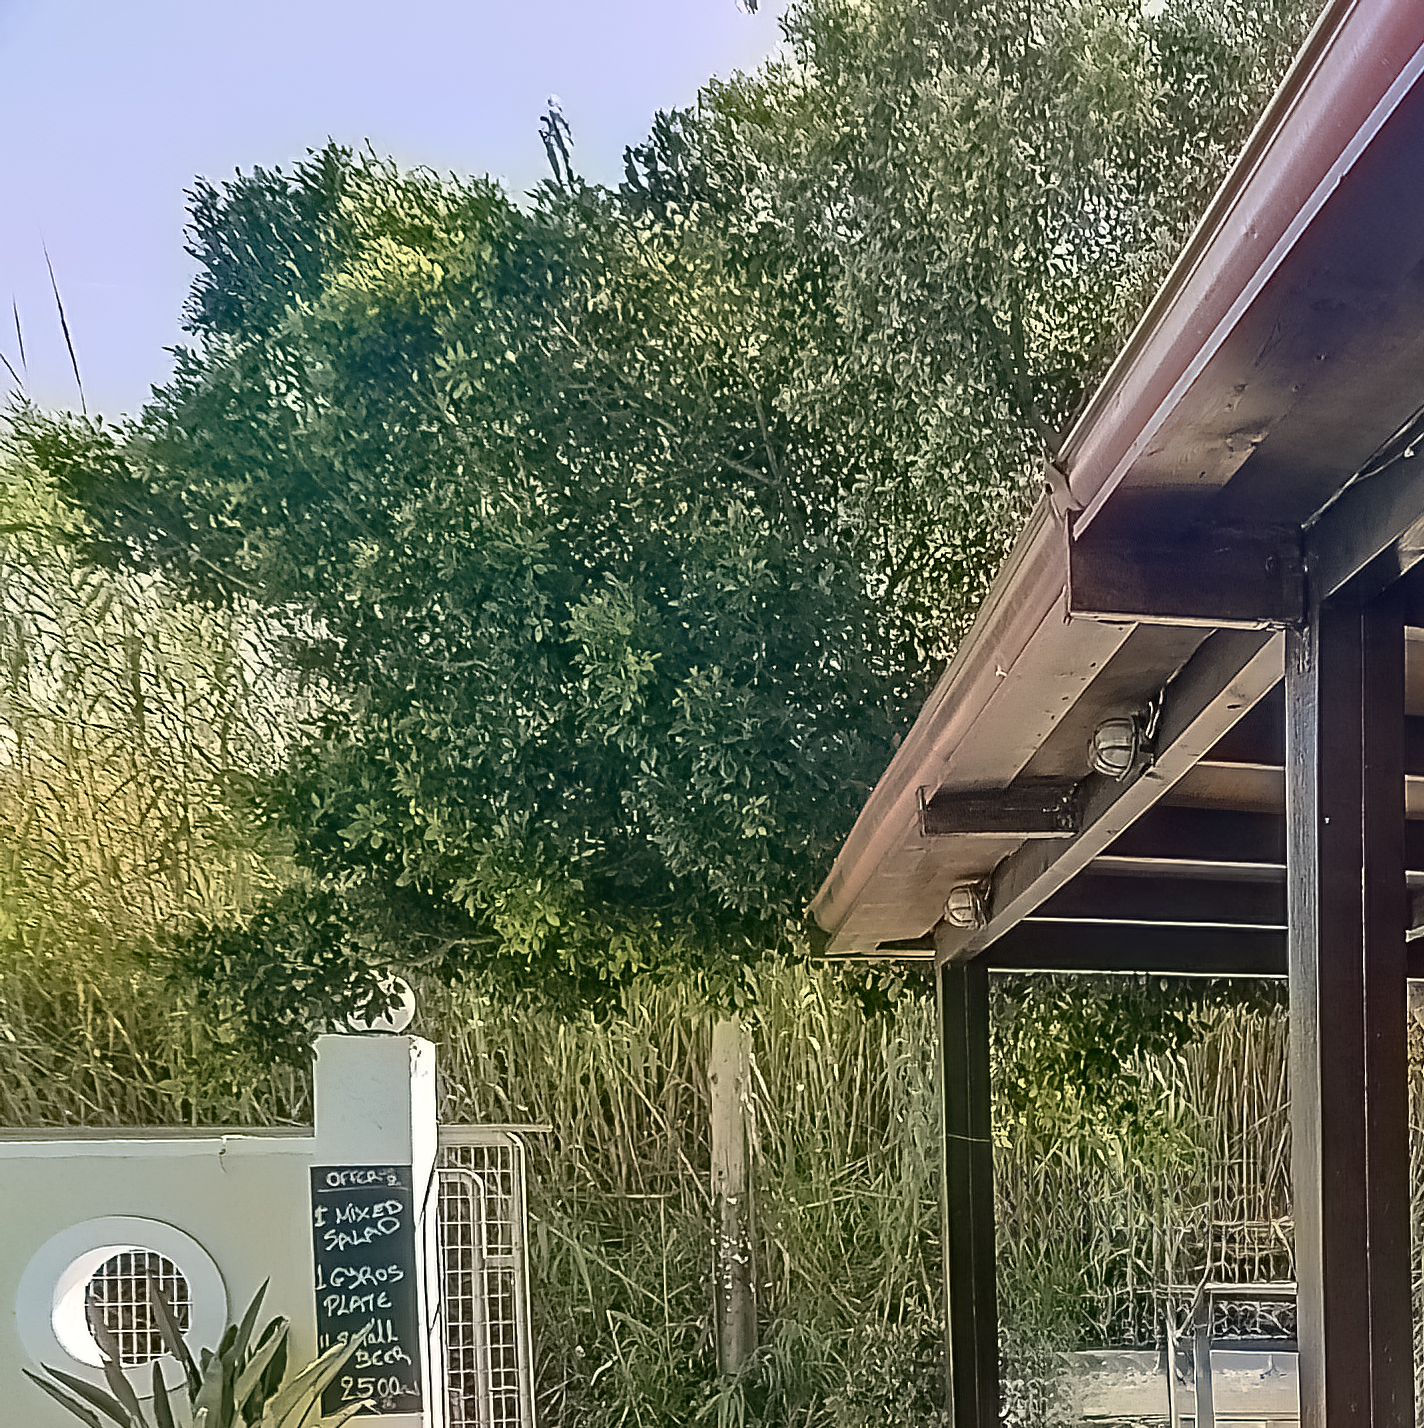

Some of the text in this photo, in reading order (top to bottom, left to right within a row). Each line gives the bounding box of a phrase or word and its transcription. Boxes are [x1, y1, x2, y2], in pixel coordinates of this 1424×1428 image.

[323, 1217, 400, 1251] SALAD
[330, 1264, 404, 1289] GYROS
[323, 1291, 392, 1317] PLATE
[355, 1344, 412, 1369] BEER
